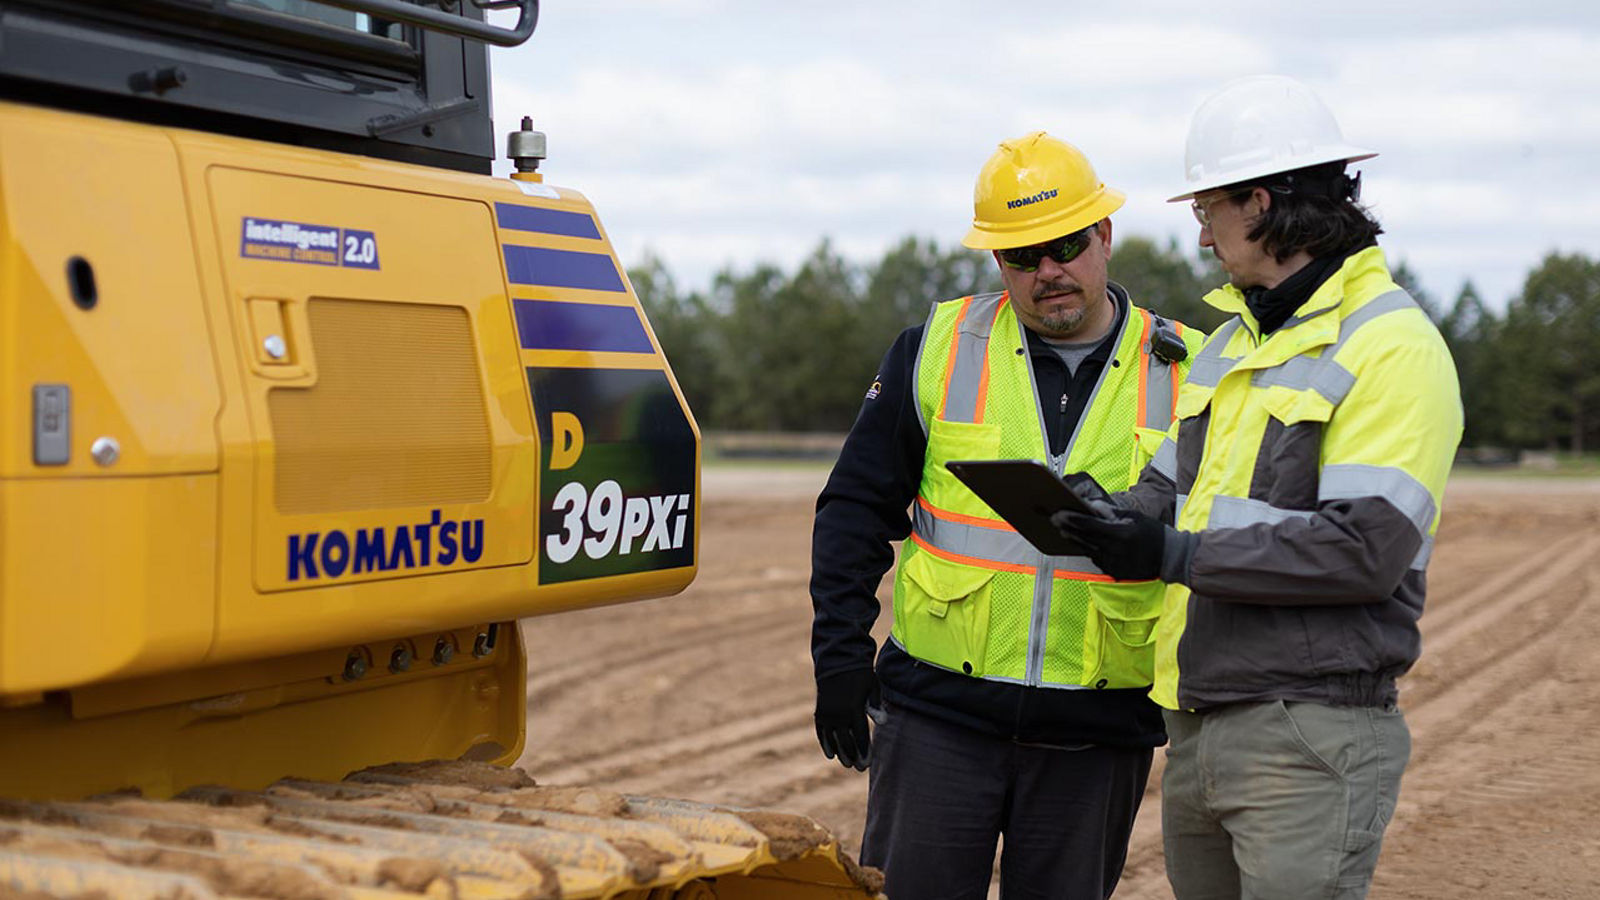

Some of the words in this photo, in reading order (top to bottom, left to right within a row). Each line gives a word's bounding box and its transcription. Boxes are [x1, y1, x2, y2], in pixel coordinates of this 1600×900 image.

[1007, 189, 1058, 209] KOMATSU
[245, 219, 338, 249] intelligent
[344, 236, 375, 263] 2.0
[549, 411, 584, 470] D
[287, 509, 484, 581] KOMATSU
